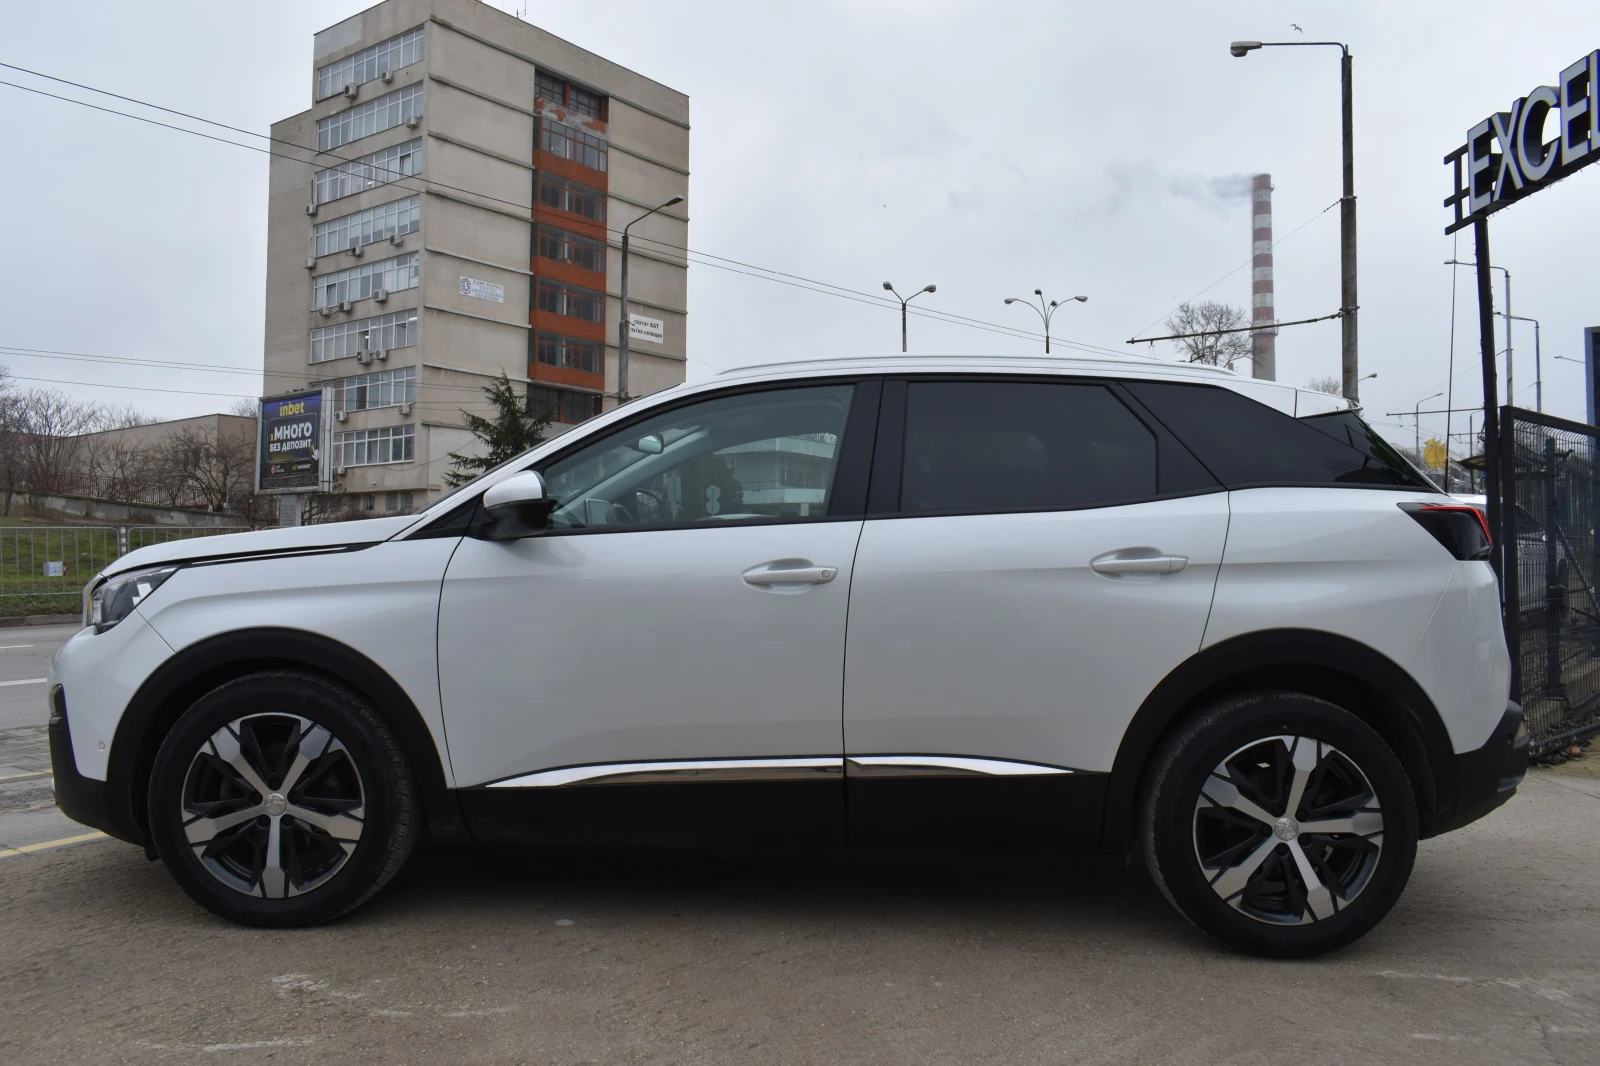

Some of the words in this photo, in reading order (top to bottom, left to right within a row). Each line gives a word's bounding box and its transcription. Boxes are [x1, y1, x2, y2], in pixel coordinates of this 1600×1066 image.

[280, 401, 304, 416] inbet
[269, 442, 281, 453] БЕЗ
[281, 438, 312, 453] ДЕПОЗИТ
